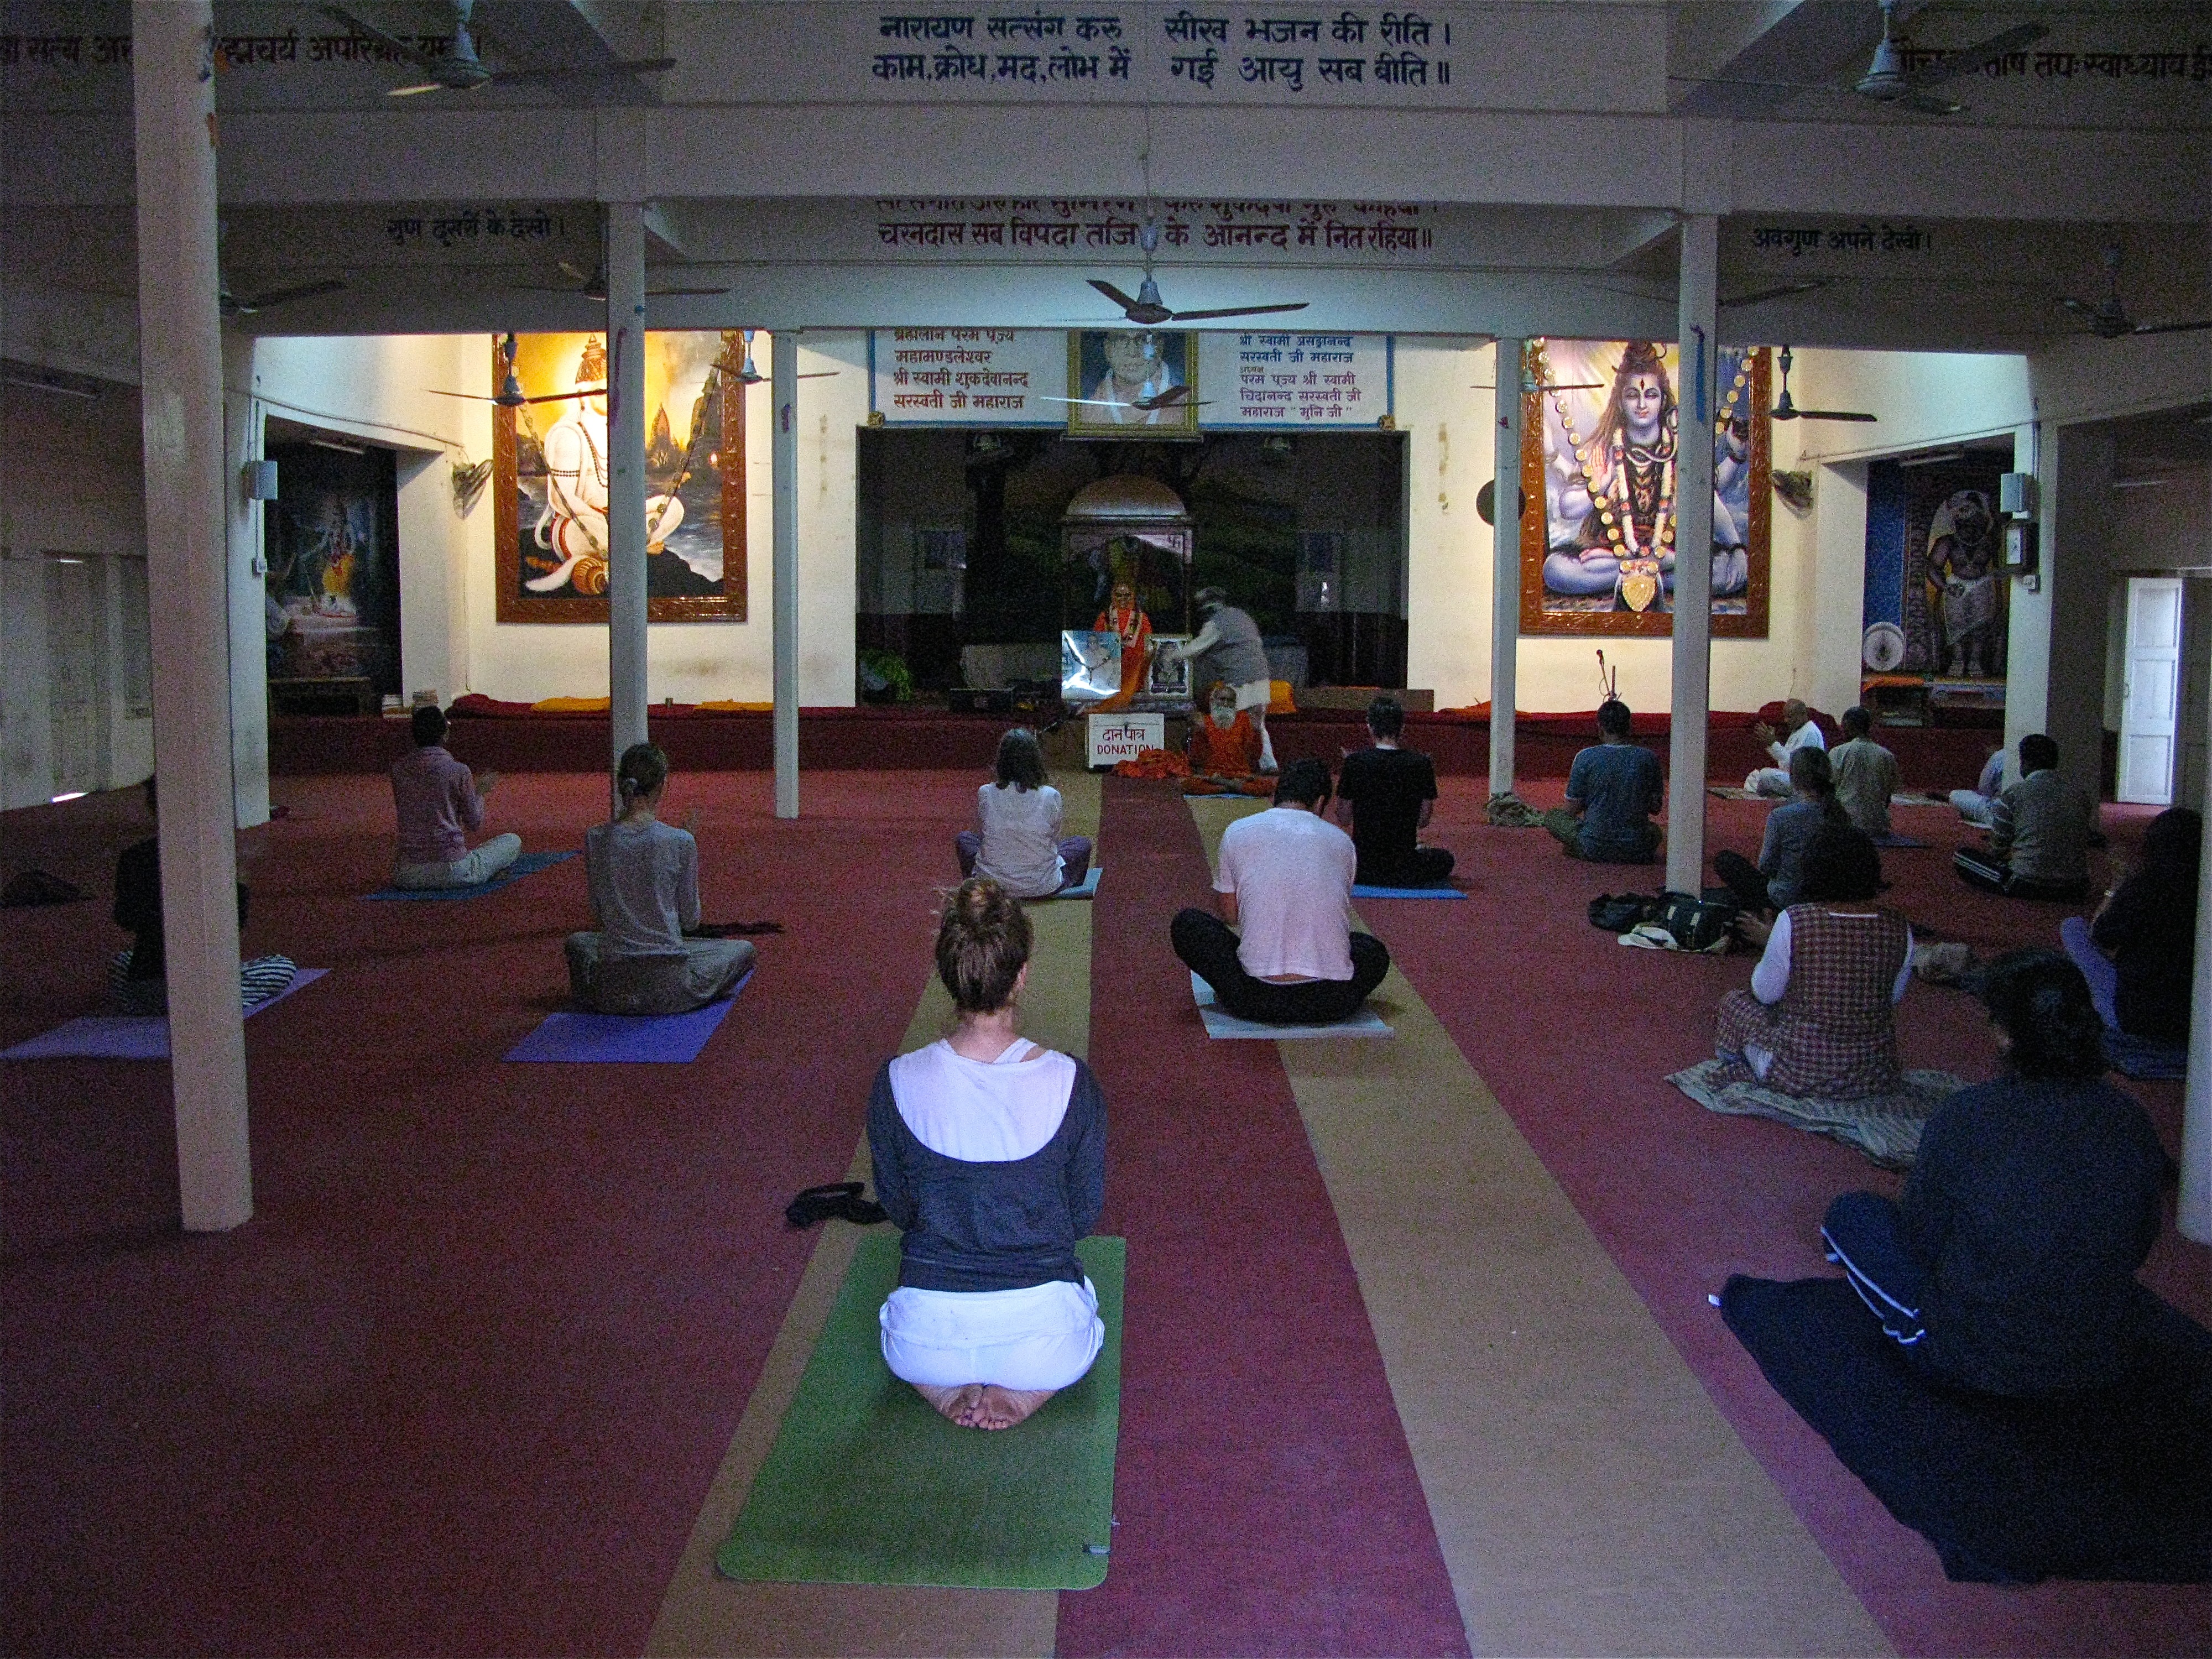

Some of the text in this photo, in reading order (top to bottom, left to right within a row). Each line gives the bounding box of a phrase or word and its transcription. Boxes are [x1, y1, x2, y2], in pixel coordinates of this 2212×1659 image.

[880, 16, 974, 40] नारायण
[987, 9, 1065, 40] सत्संग
[1164, 11, 1229, 43] सीख
[1245, 19, 1322, 43] भजन
[1332, 11, 1369, 43] की
[1108, 45, 1131, 80] में
[1171, 48, 1218, 89] गई
[1238, 57, 1304, 92] आयु
[1318, 58, 1366, 84] सब
[971, 222, 1004, 247] सब
[1010, 216, 1079, 249] विपदा
[1085, 216, 1139, 248] तजि
[1165, 216, 1190, 248] के
[1204, 221, 1290, 251] आनन्द
[1297, 217, 1318, 247] में
[1324, 219, 1365, 249] नित
[1240, 348, 1354, 363] सरस्वती जी महाराज
[894, 367, 1030, 389] श्री स्वामी शुकदेवानन्द
[1240, 371, 1357, 388] परम पूज्य श्री स्वामी
[894, 389, 1025, 409] सरस्वती जी महाराज
[1240, 387, 1363, 403] चिदानन्द सरस्वती जी
[1240, 406, 1286, 418] महाराज
[1102, 728, 1146, 741] दान पात्र
[1097, 744, 1154, 755] DONATION
